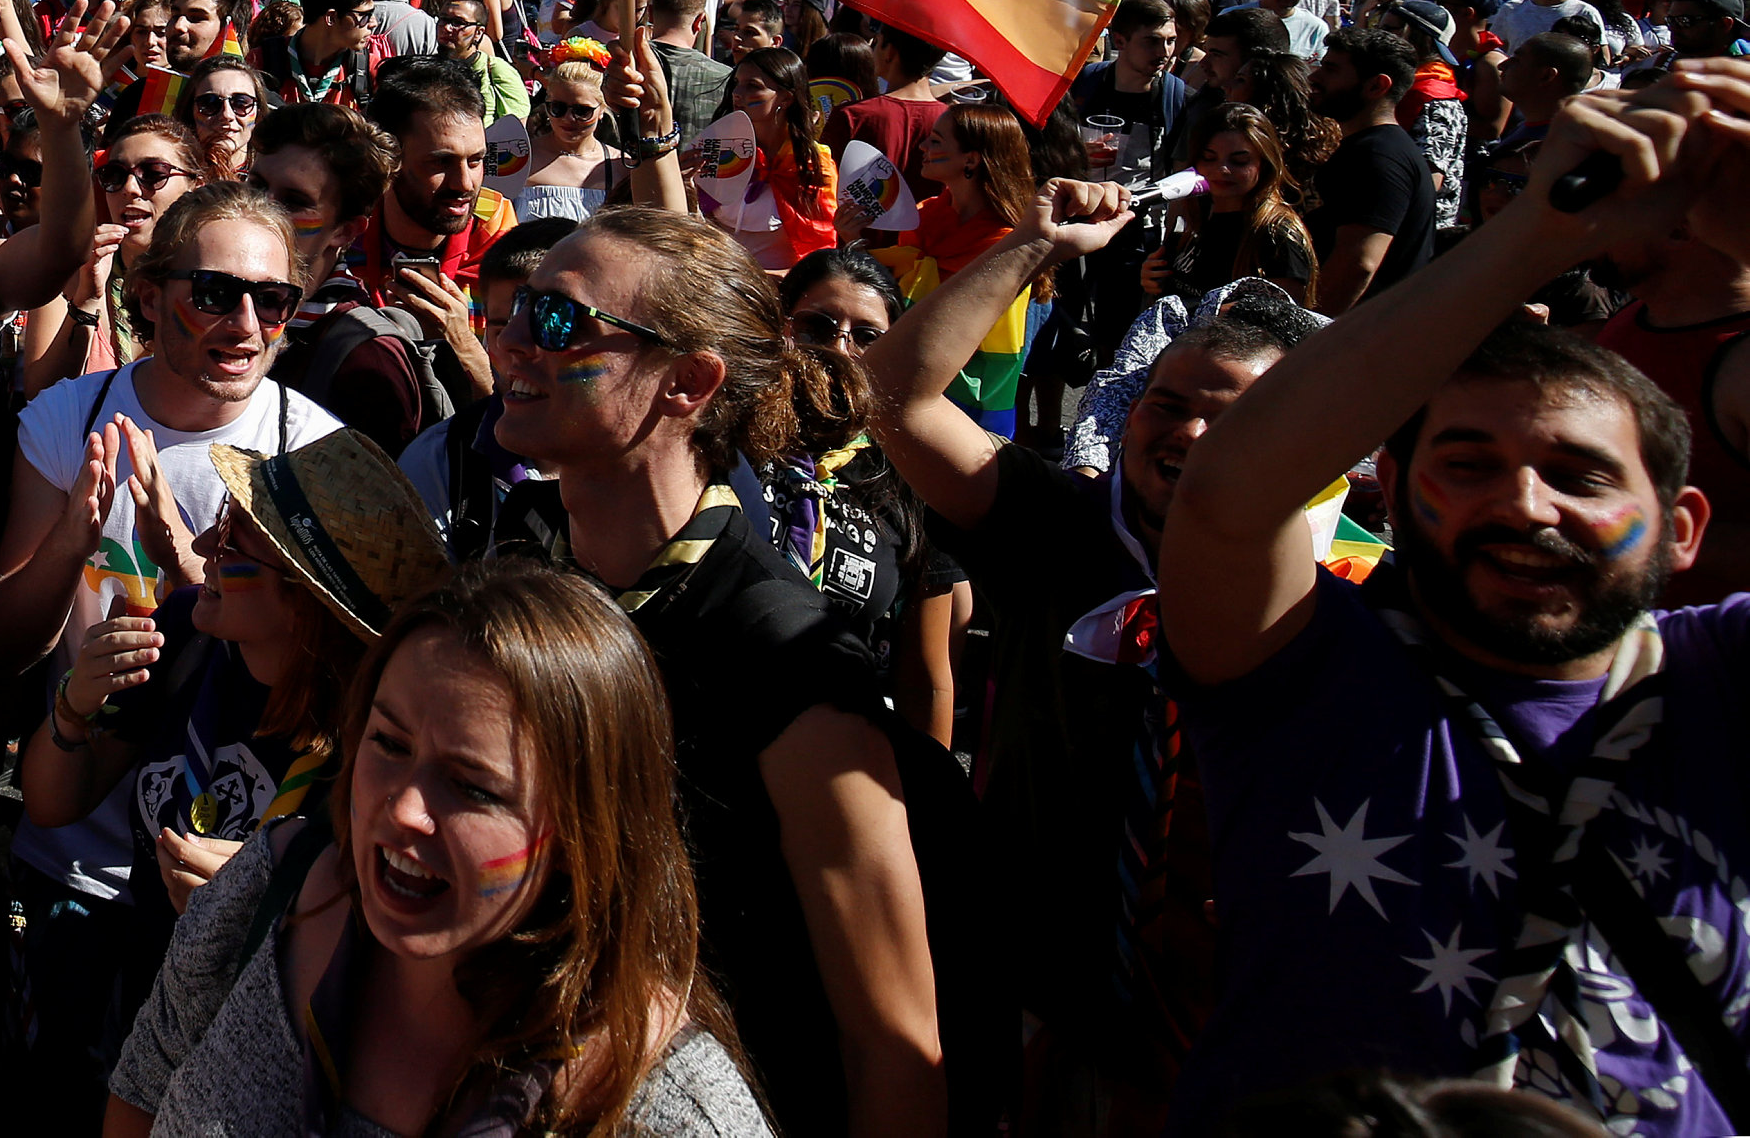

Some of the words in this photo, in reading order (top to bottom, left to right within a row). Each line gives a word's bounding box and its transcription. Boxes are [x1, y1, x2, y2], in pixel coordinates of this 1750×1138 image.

[845, 183, 862, 201] OUR
[852, 177, 877, 204] HANDS
[870, 201, 886, 218] OFF
